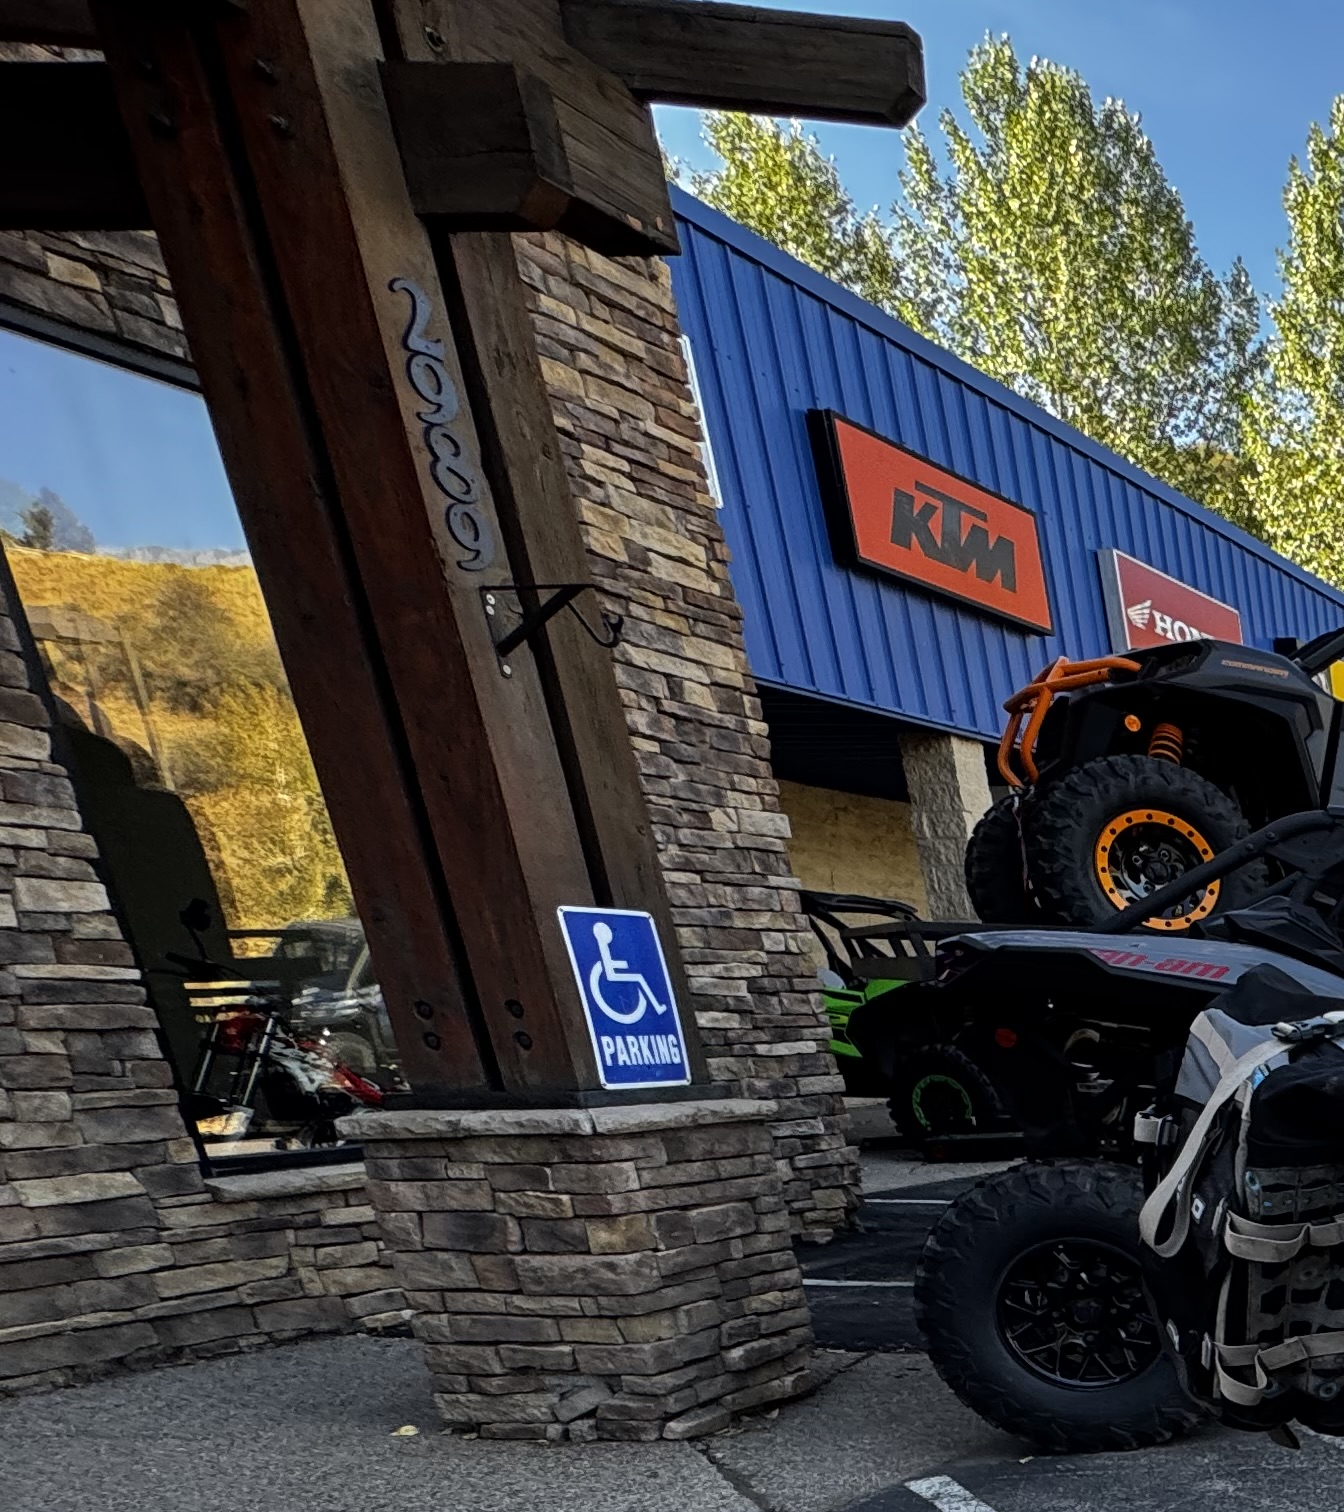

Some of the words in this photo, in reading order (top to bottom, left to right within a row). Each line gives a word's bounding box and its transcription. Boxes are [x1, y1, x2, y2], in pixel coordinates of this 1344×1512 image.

[890, 480, 1017, 594] KTM
[1152, 609, 1215, 641] HON
[601, 1034, 681, 1067] PARKING
